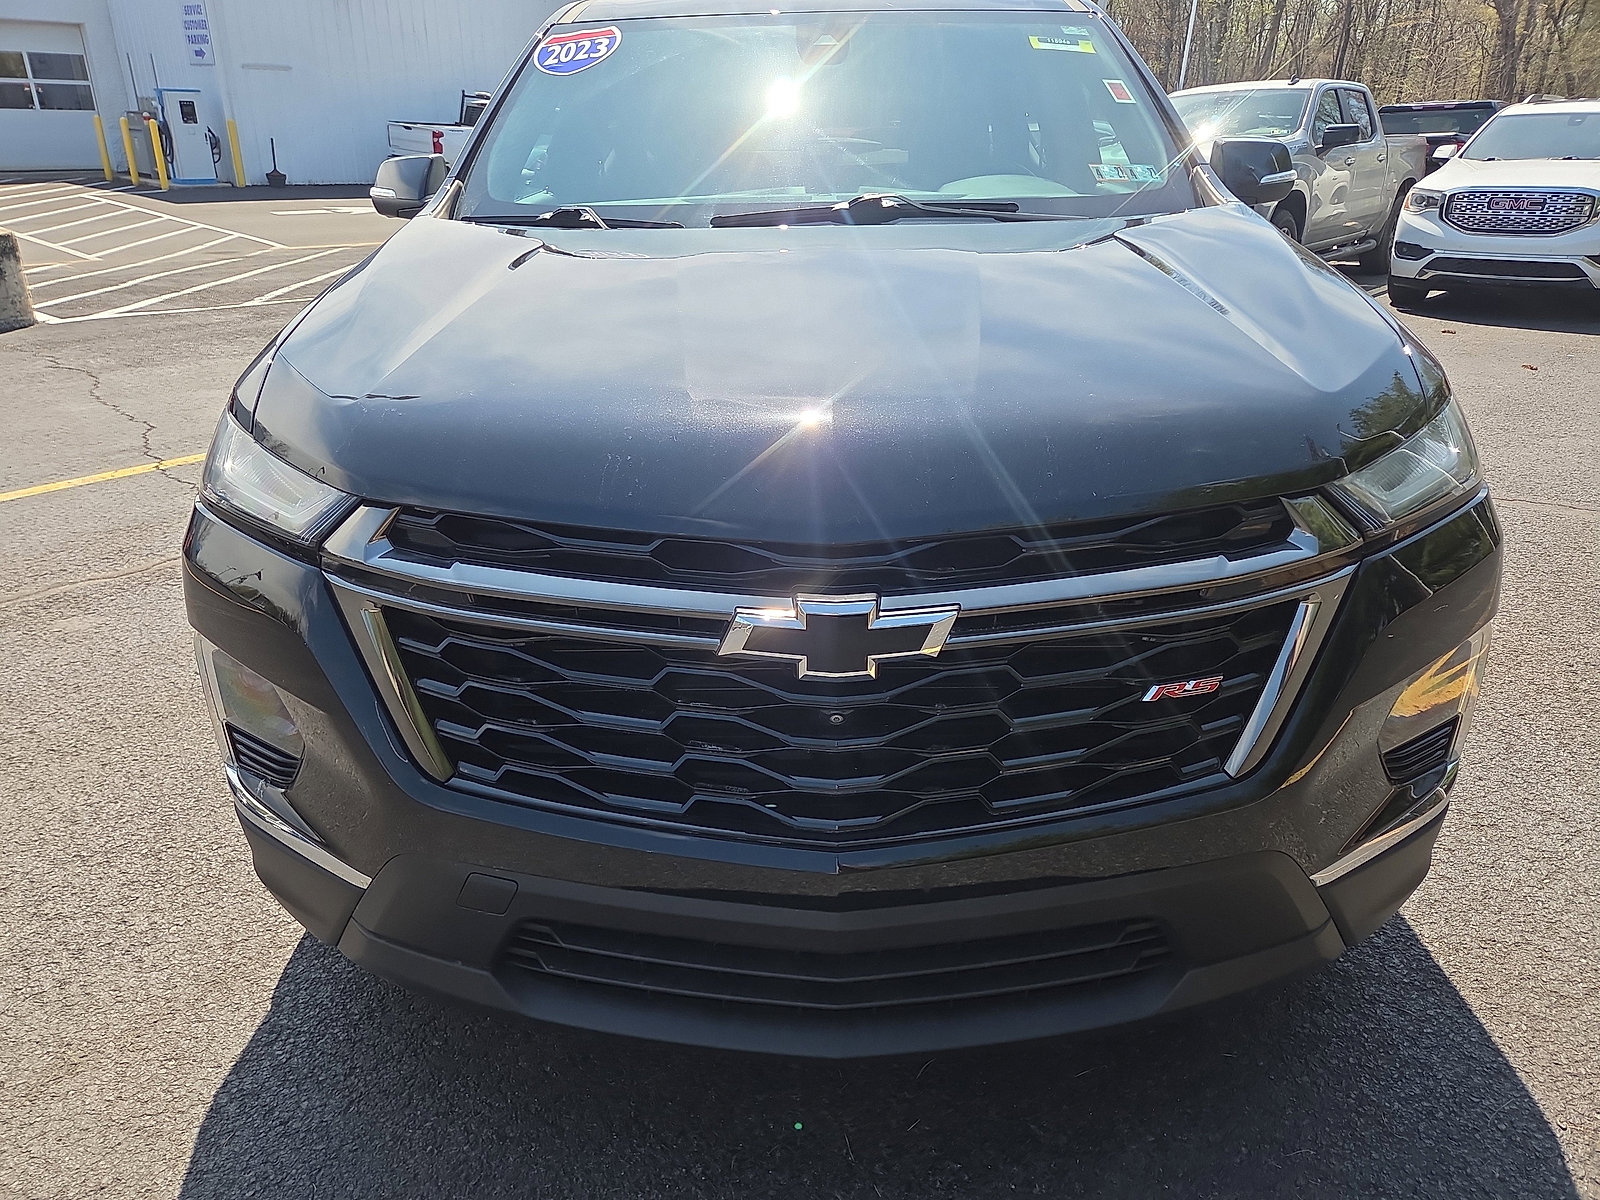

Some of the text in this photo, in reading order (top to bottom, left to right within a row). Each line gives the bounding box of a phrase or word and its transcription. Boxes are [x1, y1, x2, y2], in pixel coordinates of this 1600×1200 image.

[184, 4, 203, 15] SERVICE
[184, 19, 208, 30] CUSTOMER
[186, 34, 209, 45] PARKING
[542, 38, 610, 66] 2023
[1490, 198, 1544, 210] GMC
[1141, 676, 1224, 702] RS
